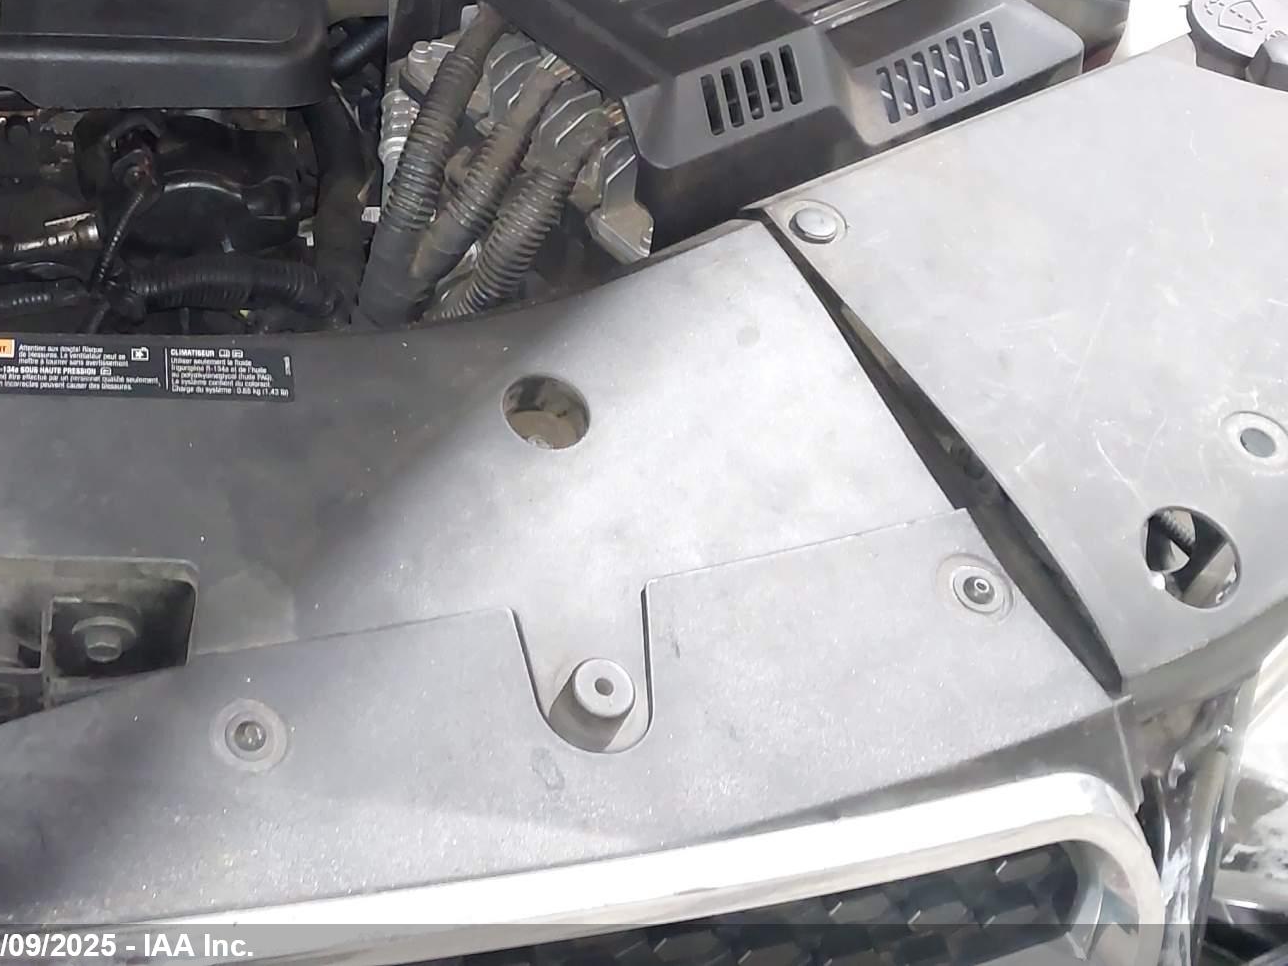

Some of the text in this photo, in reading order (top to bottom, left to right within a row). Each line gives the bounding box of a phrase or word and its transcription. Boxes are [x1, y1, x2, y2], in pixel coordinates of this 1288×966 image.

[171, 349, 214, 357] CLIMATISEUR
[20, 366, 38, 374] SOUS
[40, 366, 61, 374] HAUTE
[63, 366, 96, 375] PRESSION
